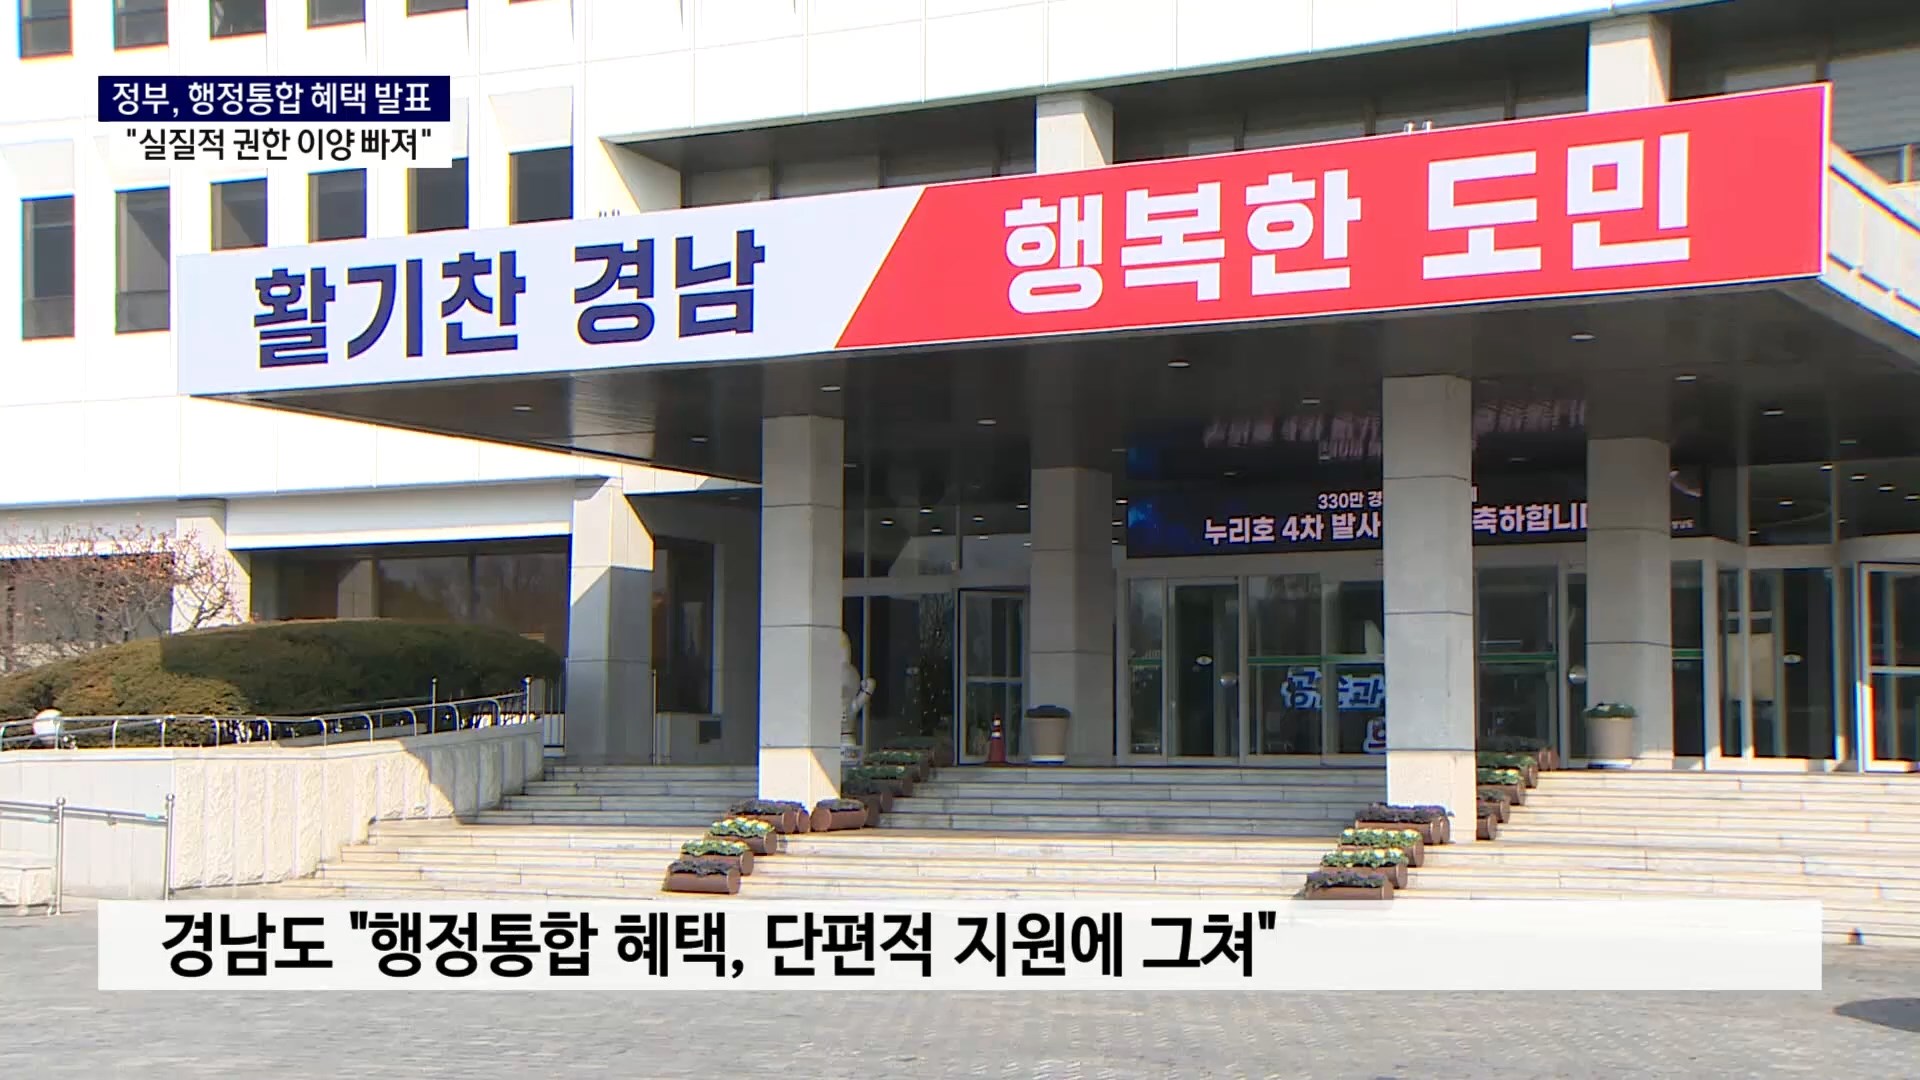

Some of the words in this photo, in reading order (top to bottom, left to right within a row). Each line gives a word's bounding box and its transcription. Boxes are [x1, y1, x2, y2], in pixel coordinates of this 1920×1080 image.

[253, 250, 526, 368] 활기찬
[574, 229, 766, 345] 경남
[1004, 168, 1362, 315] 행복한
[1422, 132, 1691, 280] 도민
[1318, 491, 1364, 510] 330만
[1204, 516, 1275, 545] 누리호
[1282, 514, 1324, 541] 4차
[1331, 512, 1382, 540] 발사
